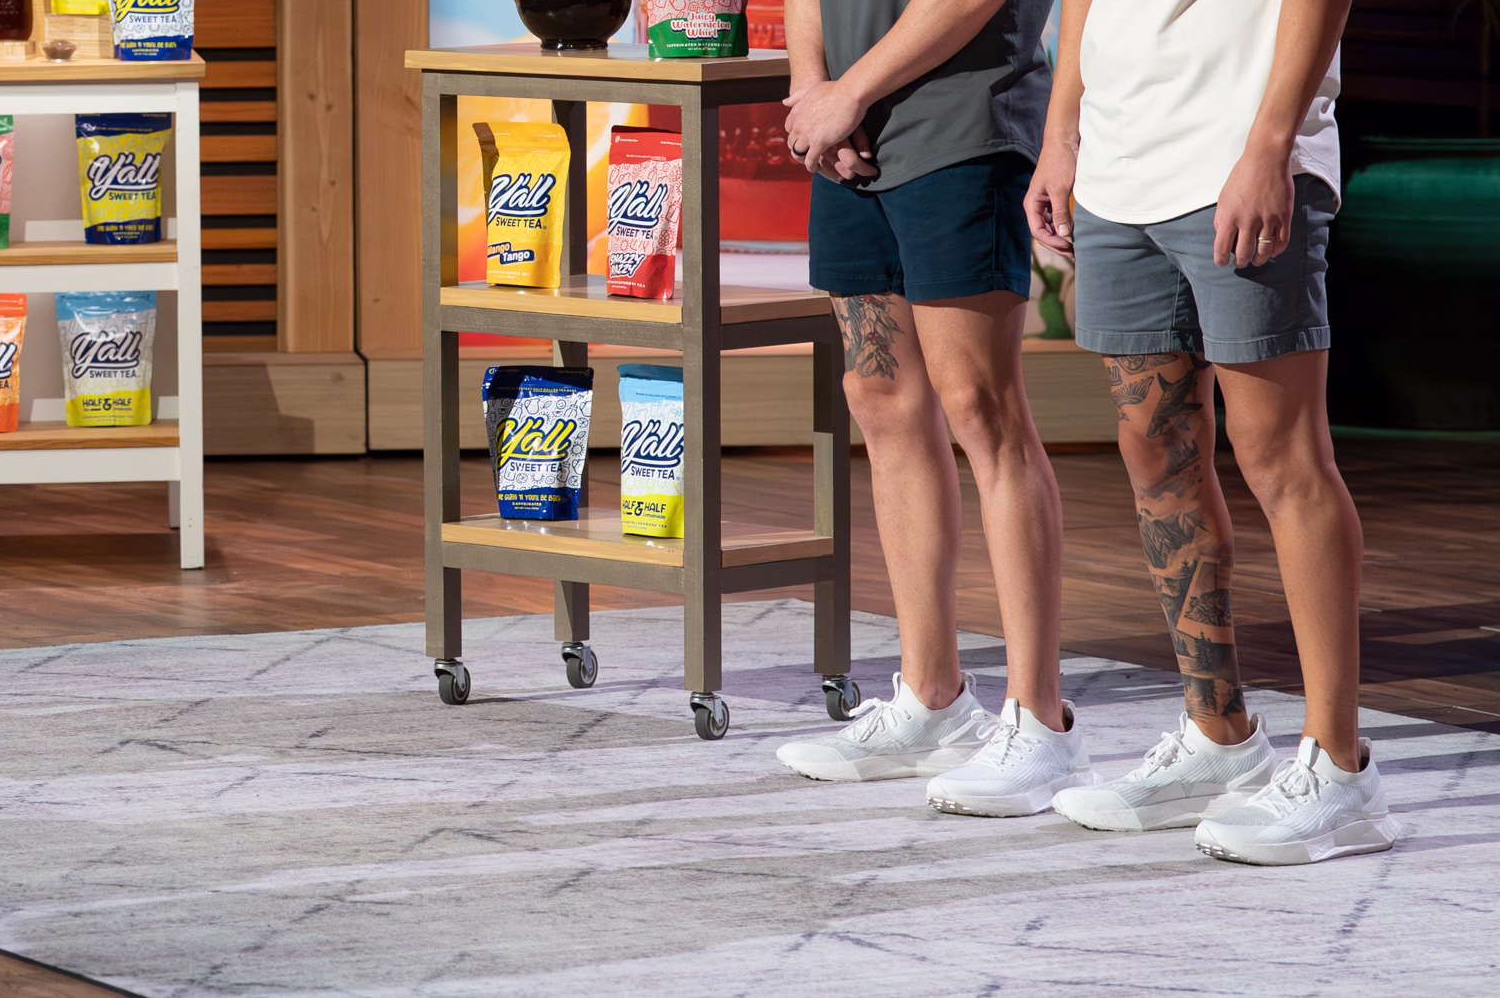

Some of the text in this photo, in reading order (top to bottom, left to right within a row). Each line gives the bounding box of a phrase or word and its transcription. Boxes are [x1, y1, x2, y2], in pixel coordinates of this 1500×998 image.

[129, 15, 177, 23] SWEET TEA
[689, 13, 715, 21] Juicy
[672, 20, 731, 29] Watermelon
[687, 28, 717, 37] Whirl
[88, 153, 161, 200] Y'all
[141, 192, 156, 200] TEA
[488, 173, 557, 225] Y'all
[607, 180, 668, 234] Y'all
[496, 216, 542, 230] SWEET TEA
[616, 226, 654, 240] SWEET TEA
[502, 251, 530, 262] Tango
[71, 330, 142, 379] Y'all
[90, 370, 137, 378] SWEET TEA
[497, 417, 577, 468] Y'all
[622, 419, 683, 473] Y'all
[510, 461, 563, 472] SWEET TEA
[631, 466, 675, 480] SWEET TEA
[634, 501, 644, 516] &
[644, 502, 667, 513] HALF
